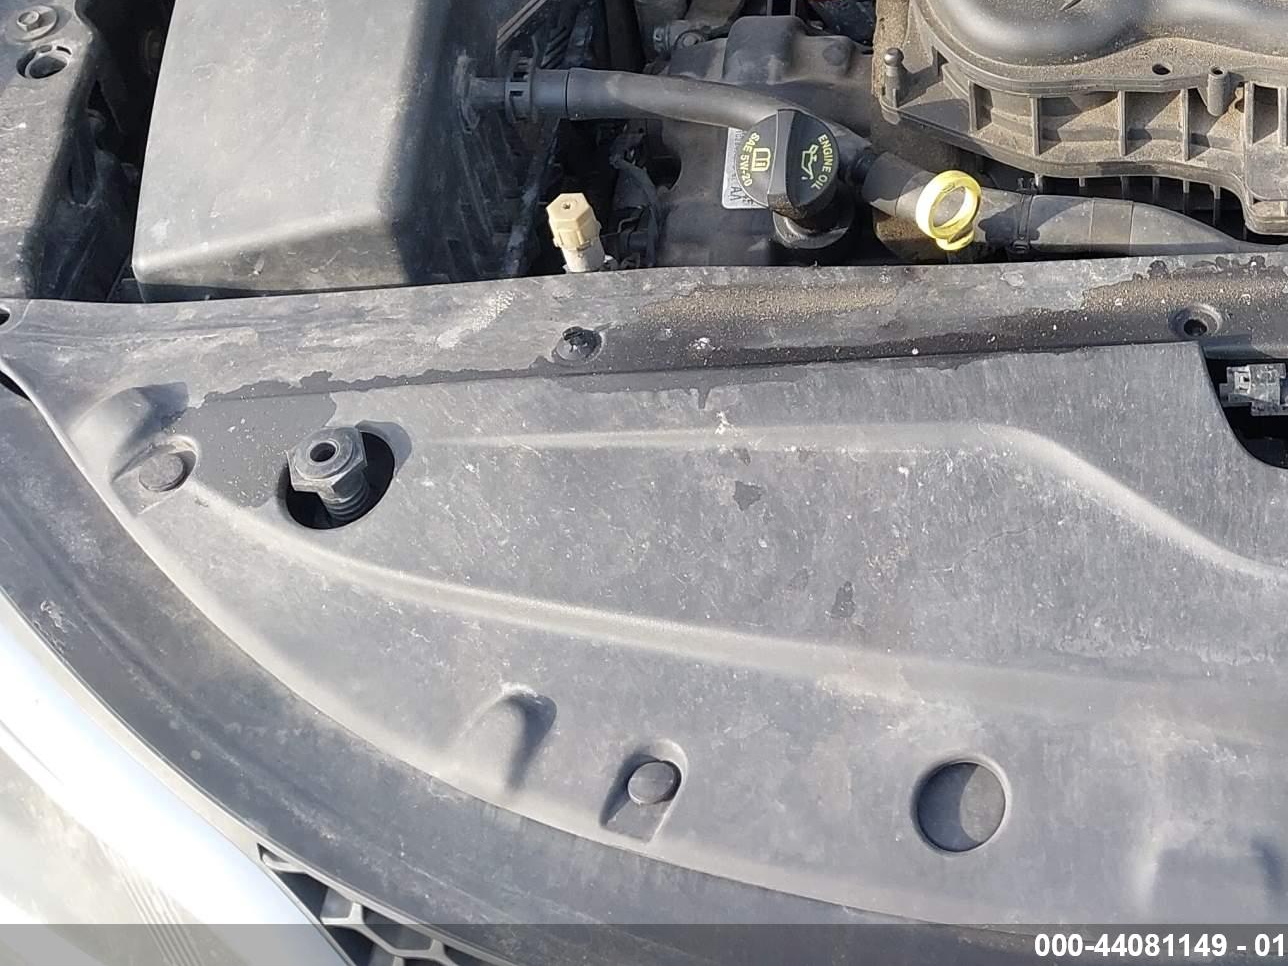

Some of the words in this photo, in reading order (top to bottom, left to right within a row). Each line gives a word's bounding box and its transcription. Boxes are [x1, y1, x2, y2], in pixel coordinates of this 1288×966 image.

[743, 132, 761, 155] SAE
[818, 134, 834, 174] ENGINE
[738, 154, 753, 187] 5W-20
[810, 174, 829, 191] OIL
